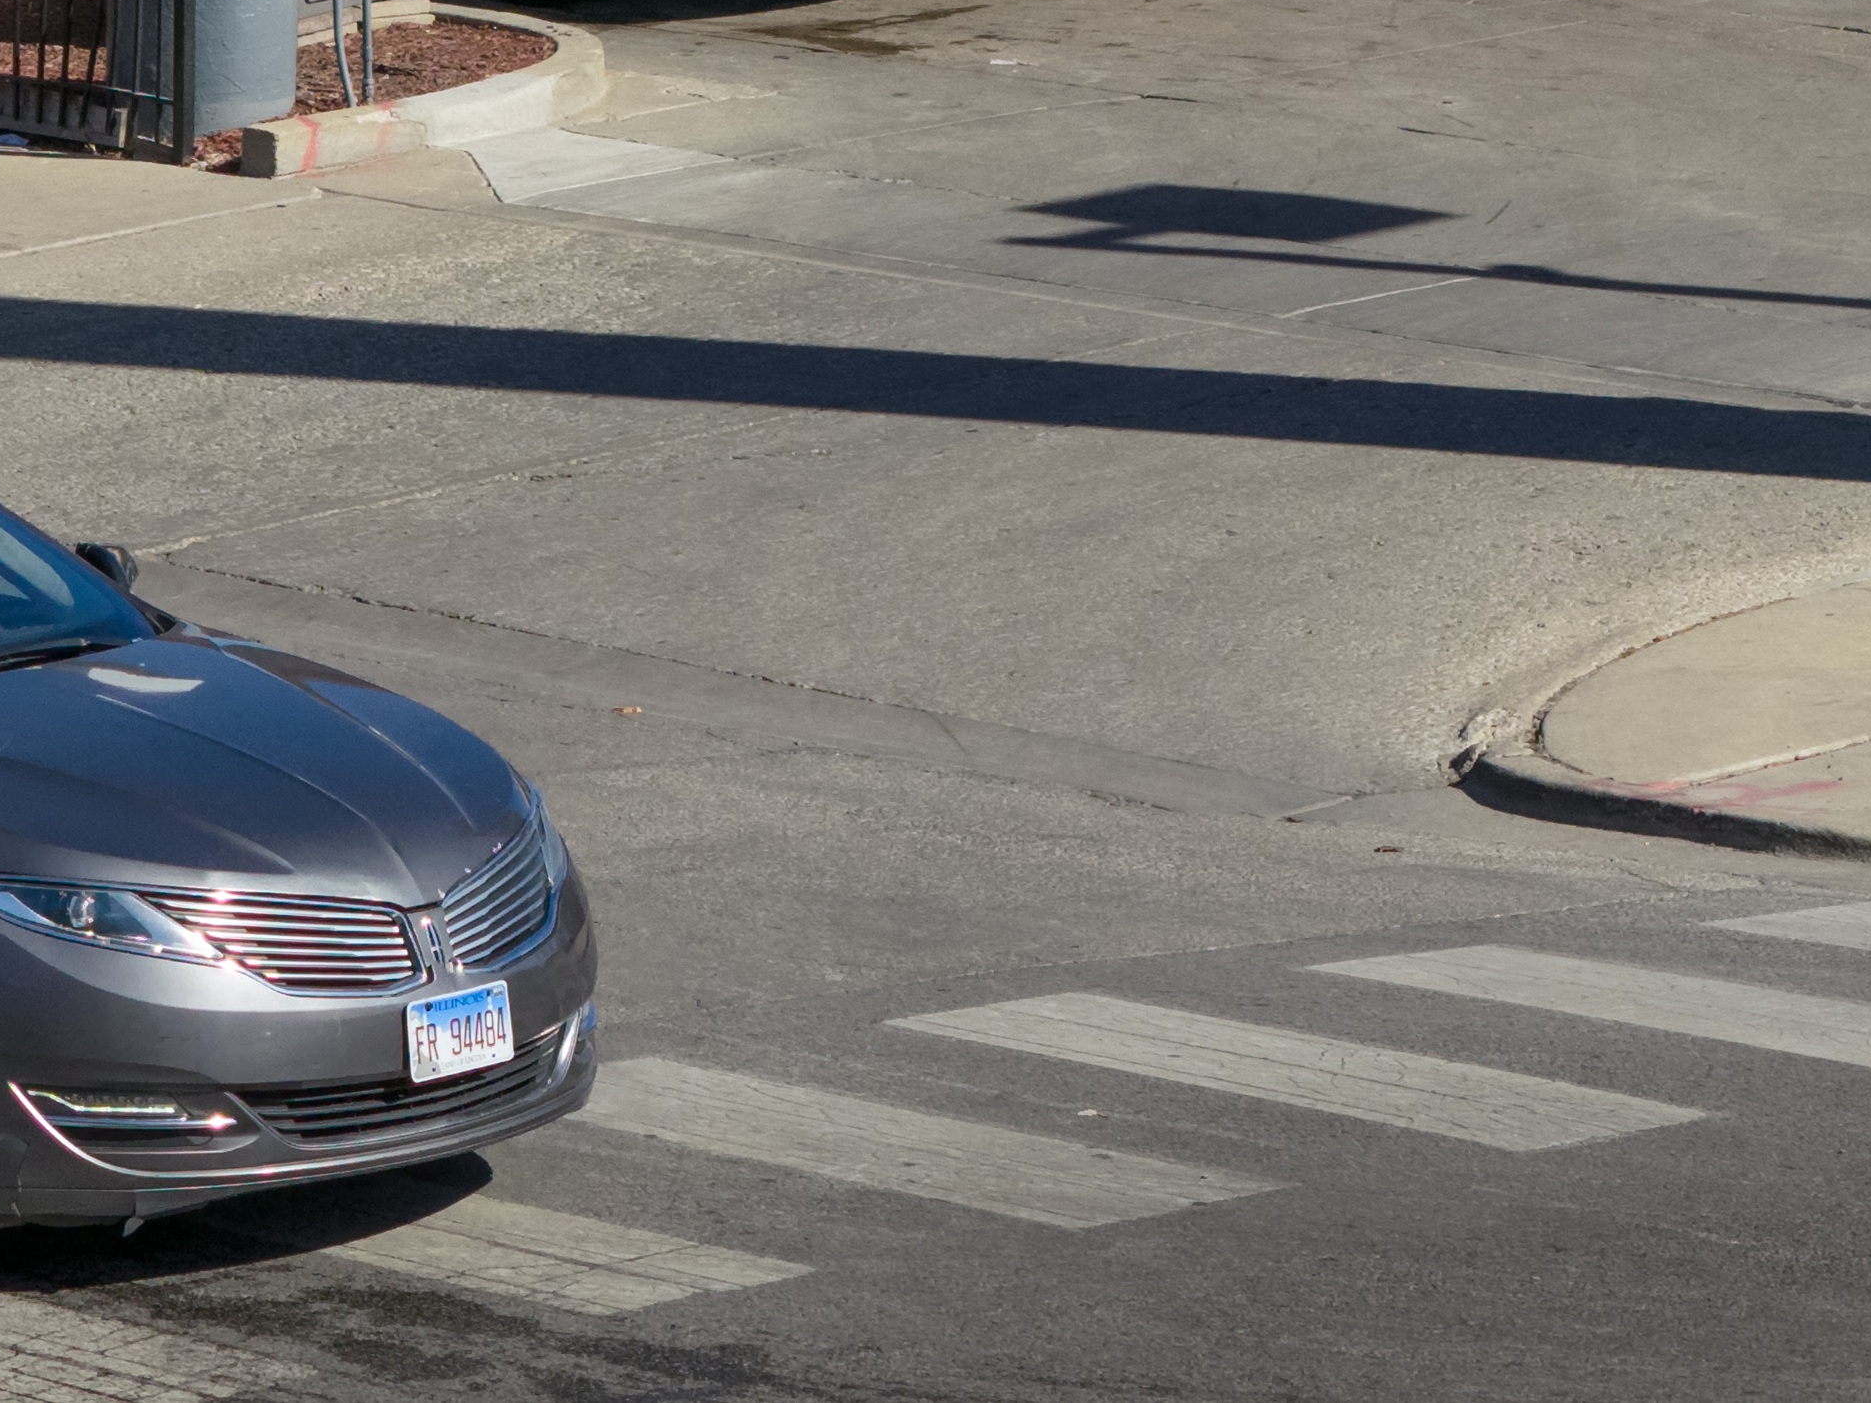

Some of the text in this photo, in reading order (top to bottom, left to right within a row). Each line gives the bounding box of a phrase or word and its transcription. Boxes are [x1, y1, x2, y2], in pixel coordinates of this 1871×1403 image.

[434, 991, 484, 1012] ILLINOIS
[415, 1006, 506, 1065] FR 94484
